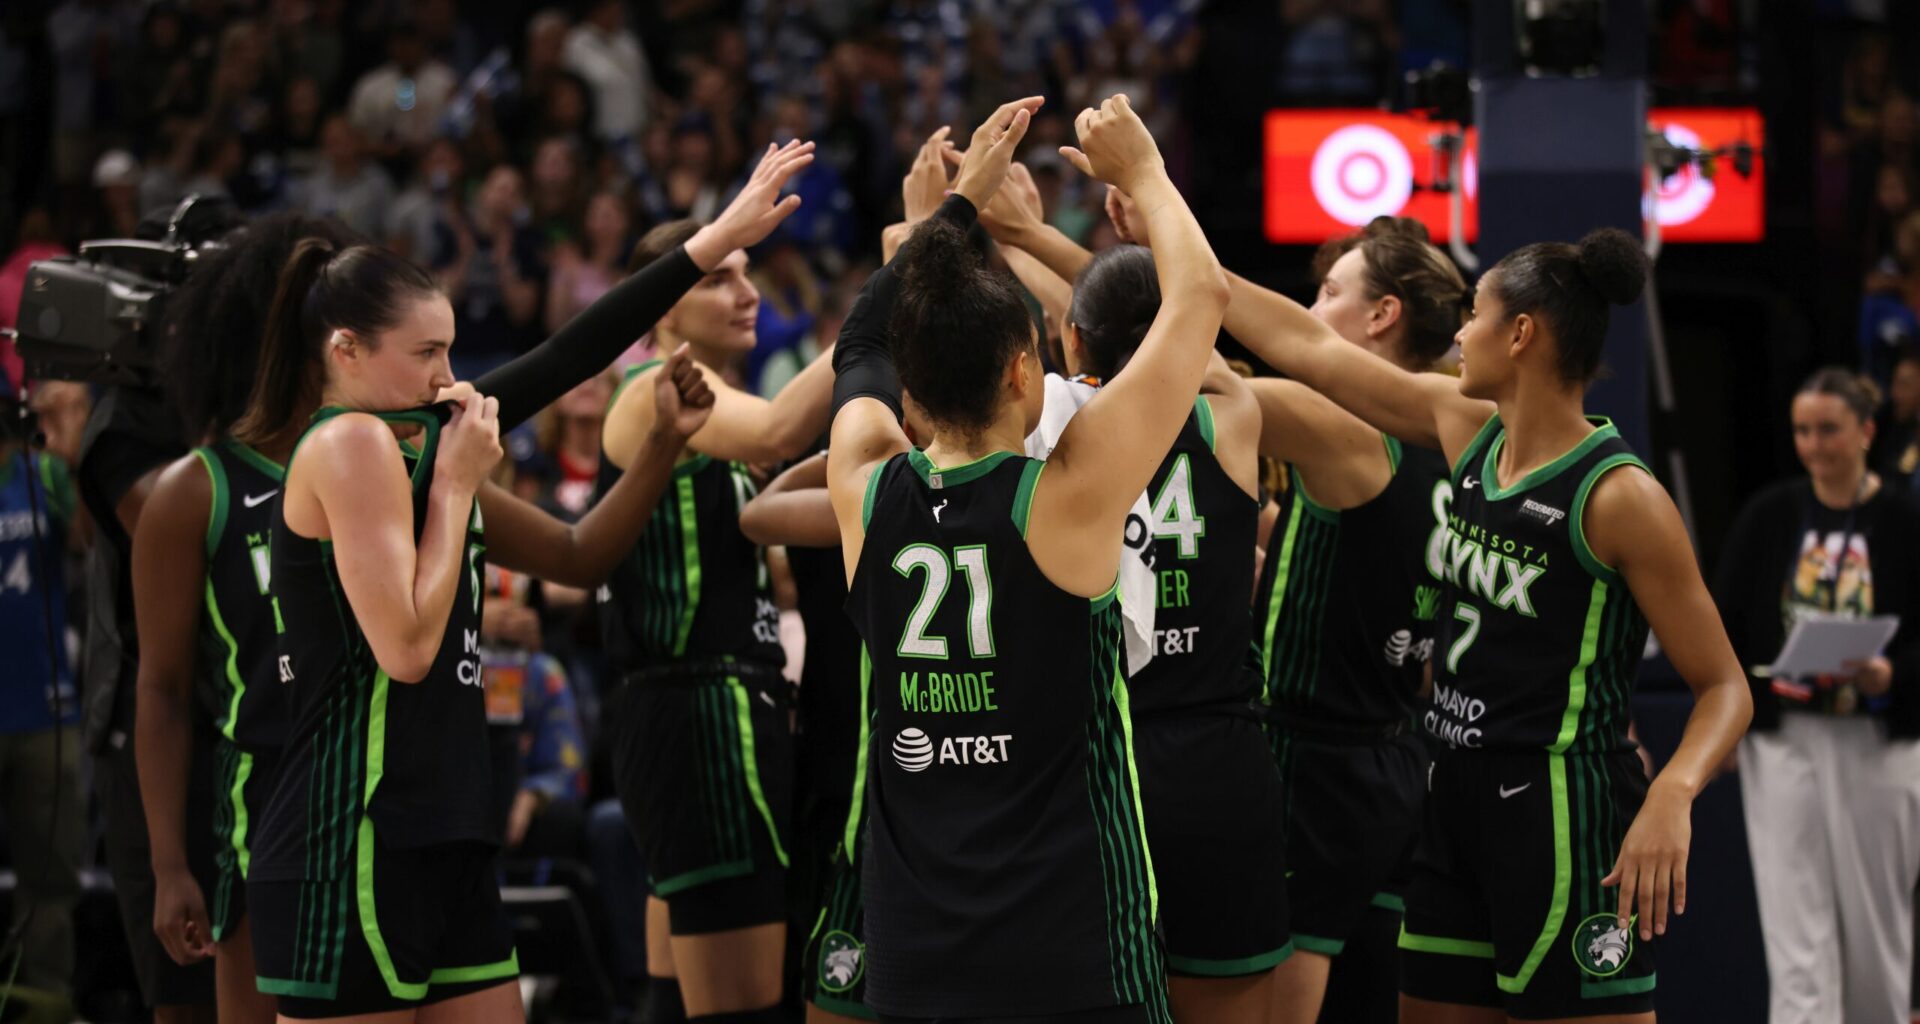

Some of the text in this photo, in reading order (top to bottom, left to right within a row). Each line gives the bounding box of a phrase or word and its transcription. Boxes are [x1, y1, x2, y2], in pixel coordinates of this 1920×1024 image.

[1522, 498, 1566, 520] FEDERATED
[1443, 527, 1547, 618] LYNX
[891, 542, 997, 661] 21
[1446, 602, 1481, 675] 7
[900, 671, 999, 713] McBRIDE
[1433, 680, 1486, 722] MAYO
[939, 734, 1013, 765] AT&T
[1424, 710, 1483, 749] CLINIC
